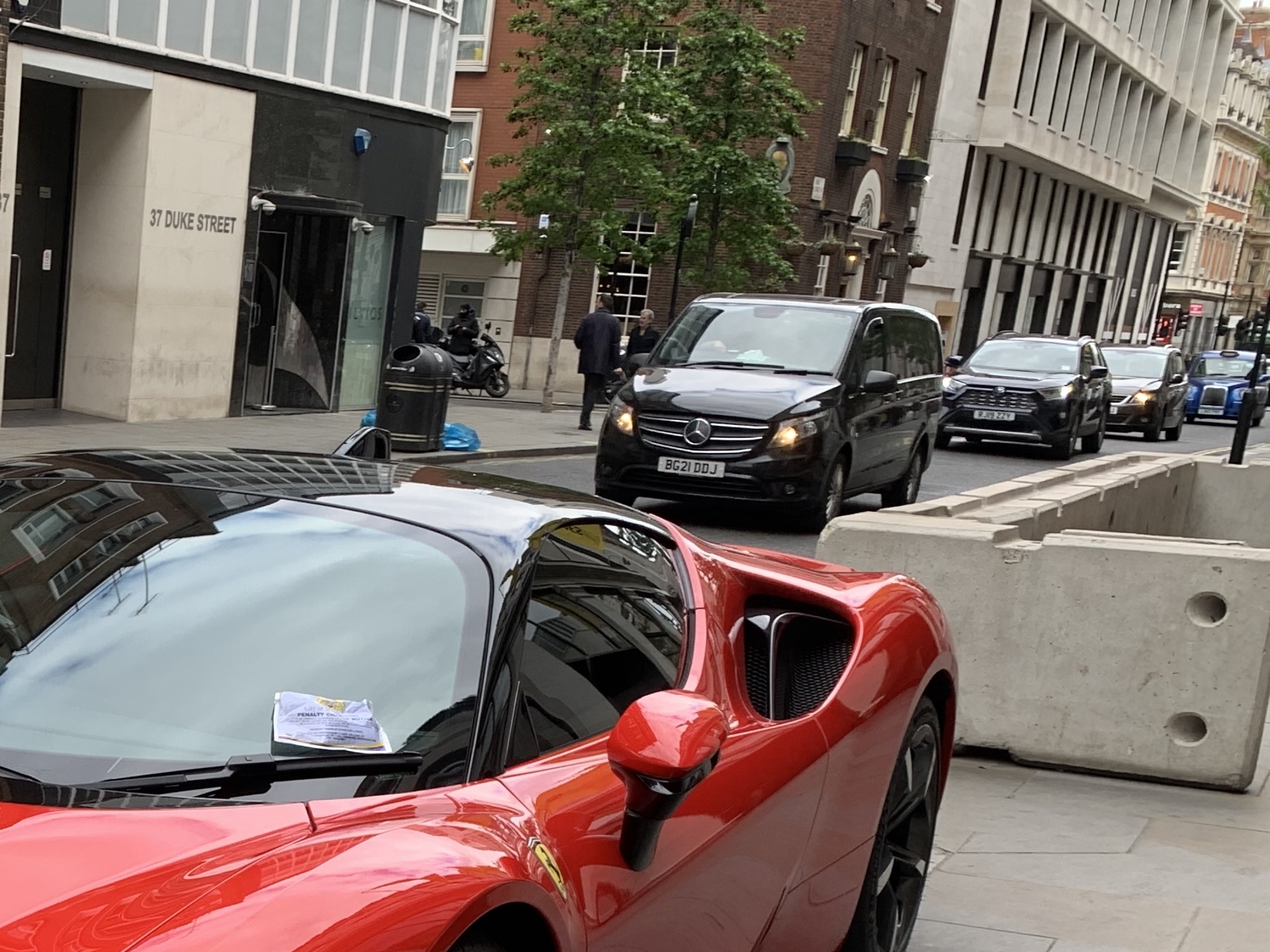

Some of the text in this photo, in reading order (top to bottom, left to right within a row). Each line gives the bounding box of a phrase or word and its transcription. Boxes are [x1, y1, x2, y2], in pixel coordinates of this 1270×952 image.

[150, 208, 237, 234] 37 DUKE STREET
[665, 459, 718, 475] BG21 DDJ
